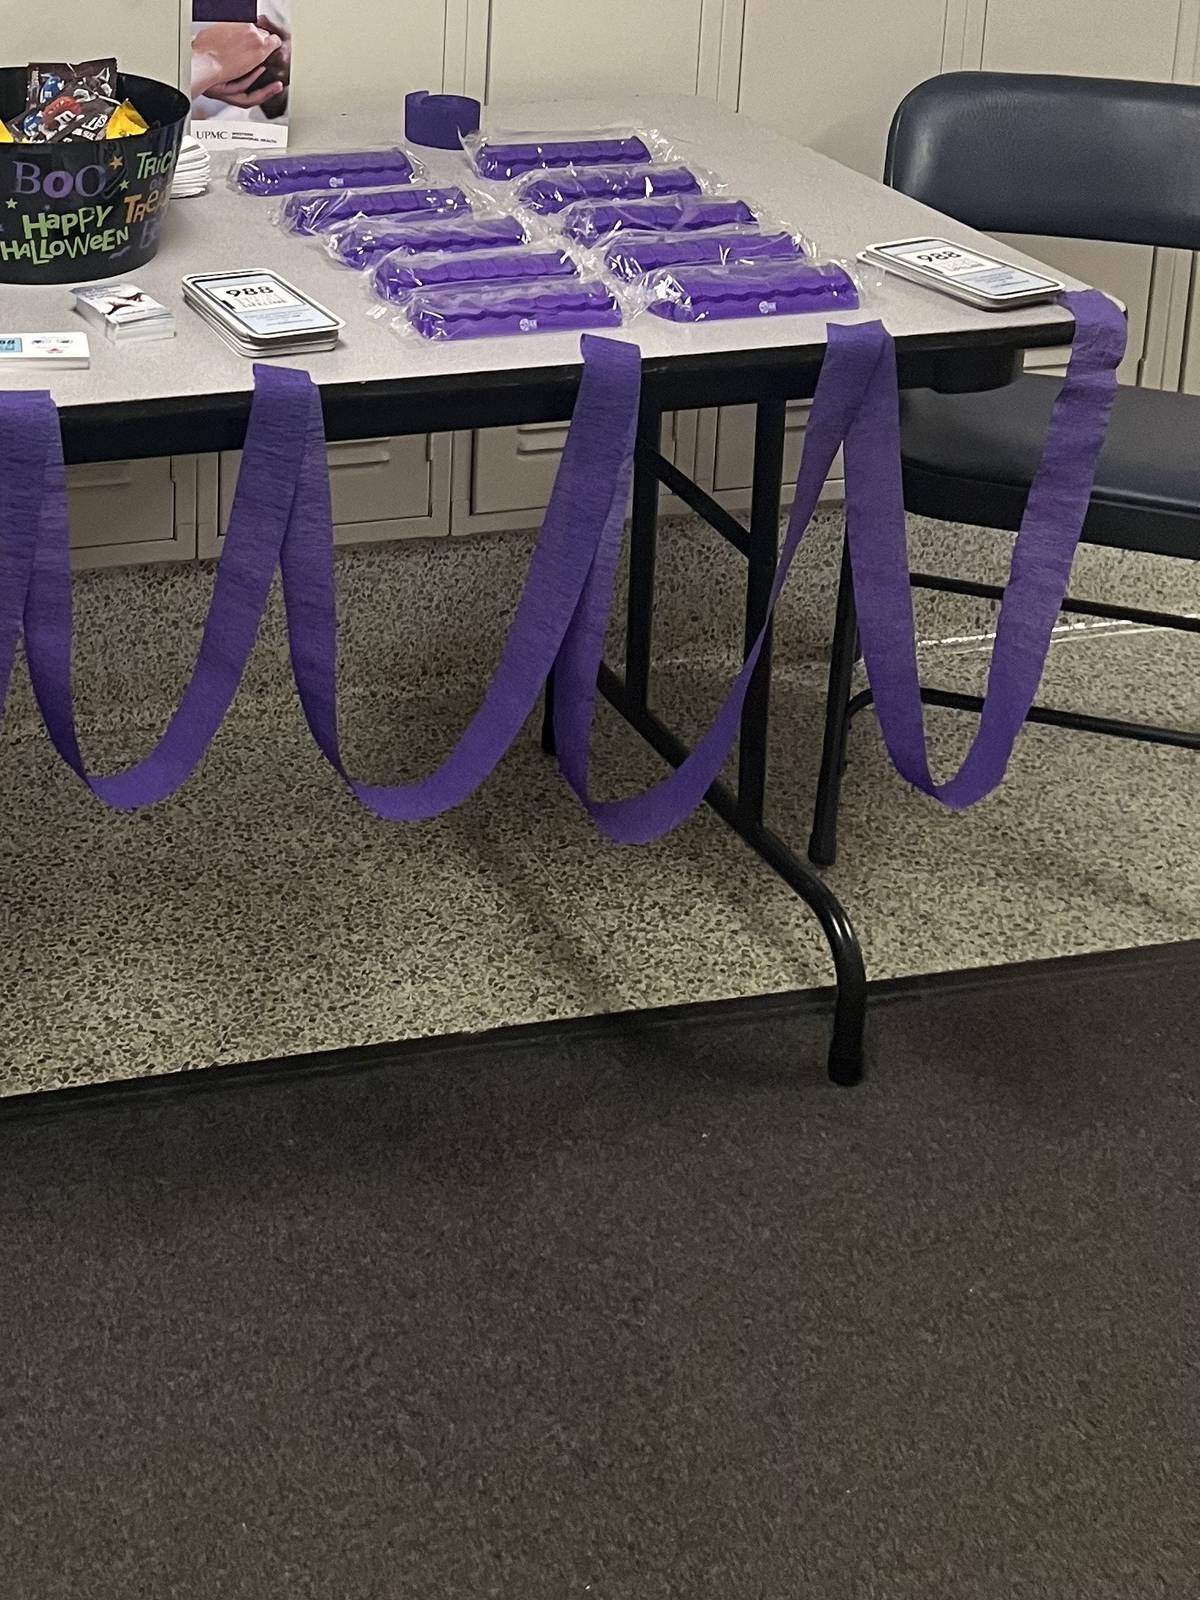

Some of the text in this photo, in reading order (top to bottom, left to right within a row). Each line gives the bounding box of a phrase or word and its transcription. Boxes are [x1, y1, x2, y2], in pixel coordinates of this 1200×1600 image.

[196, 130, 229, 140] UPMC
[916, 250, 962, 262] 988
[226, 286, 274, 297] 988
